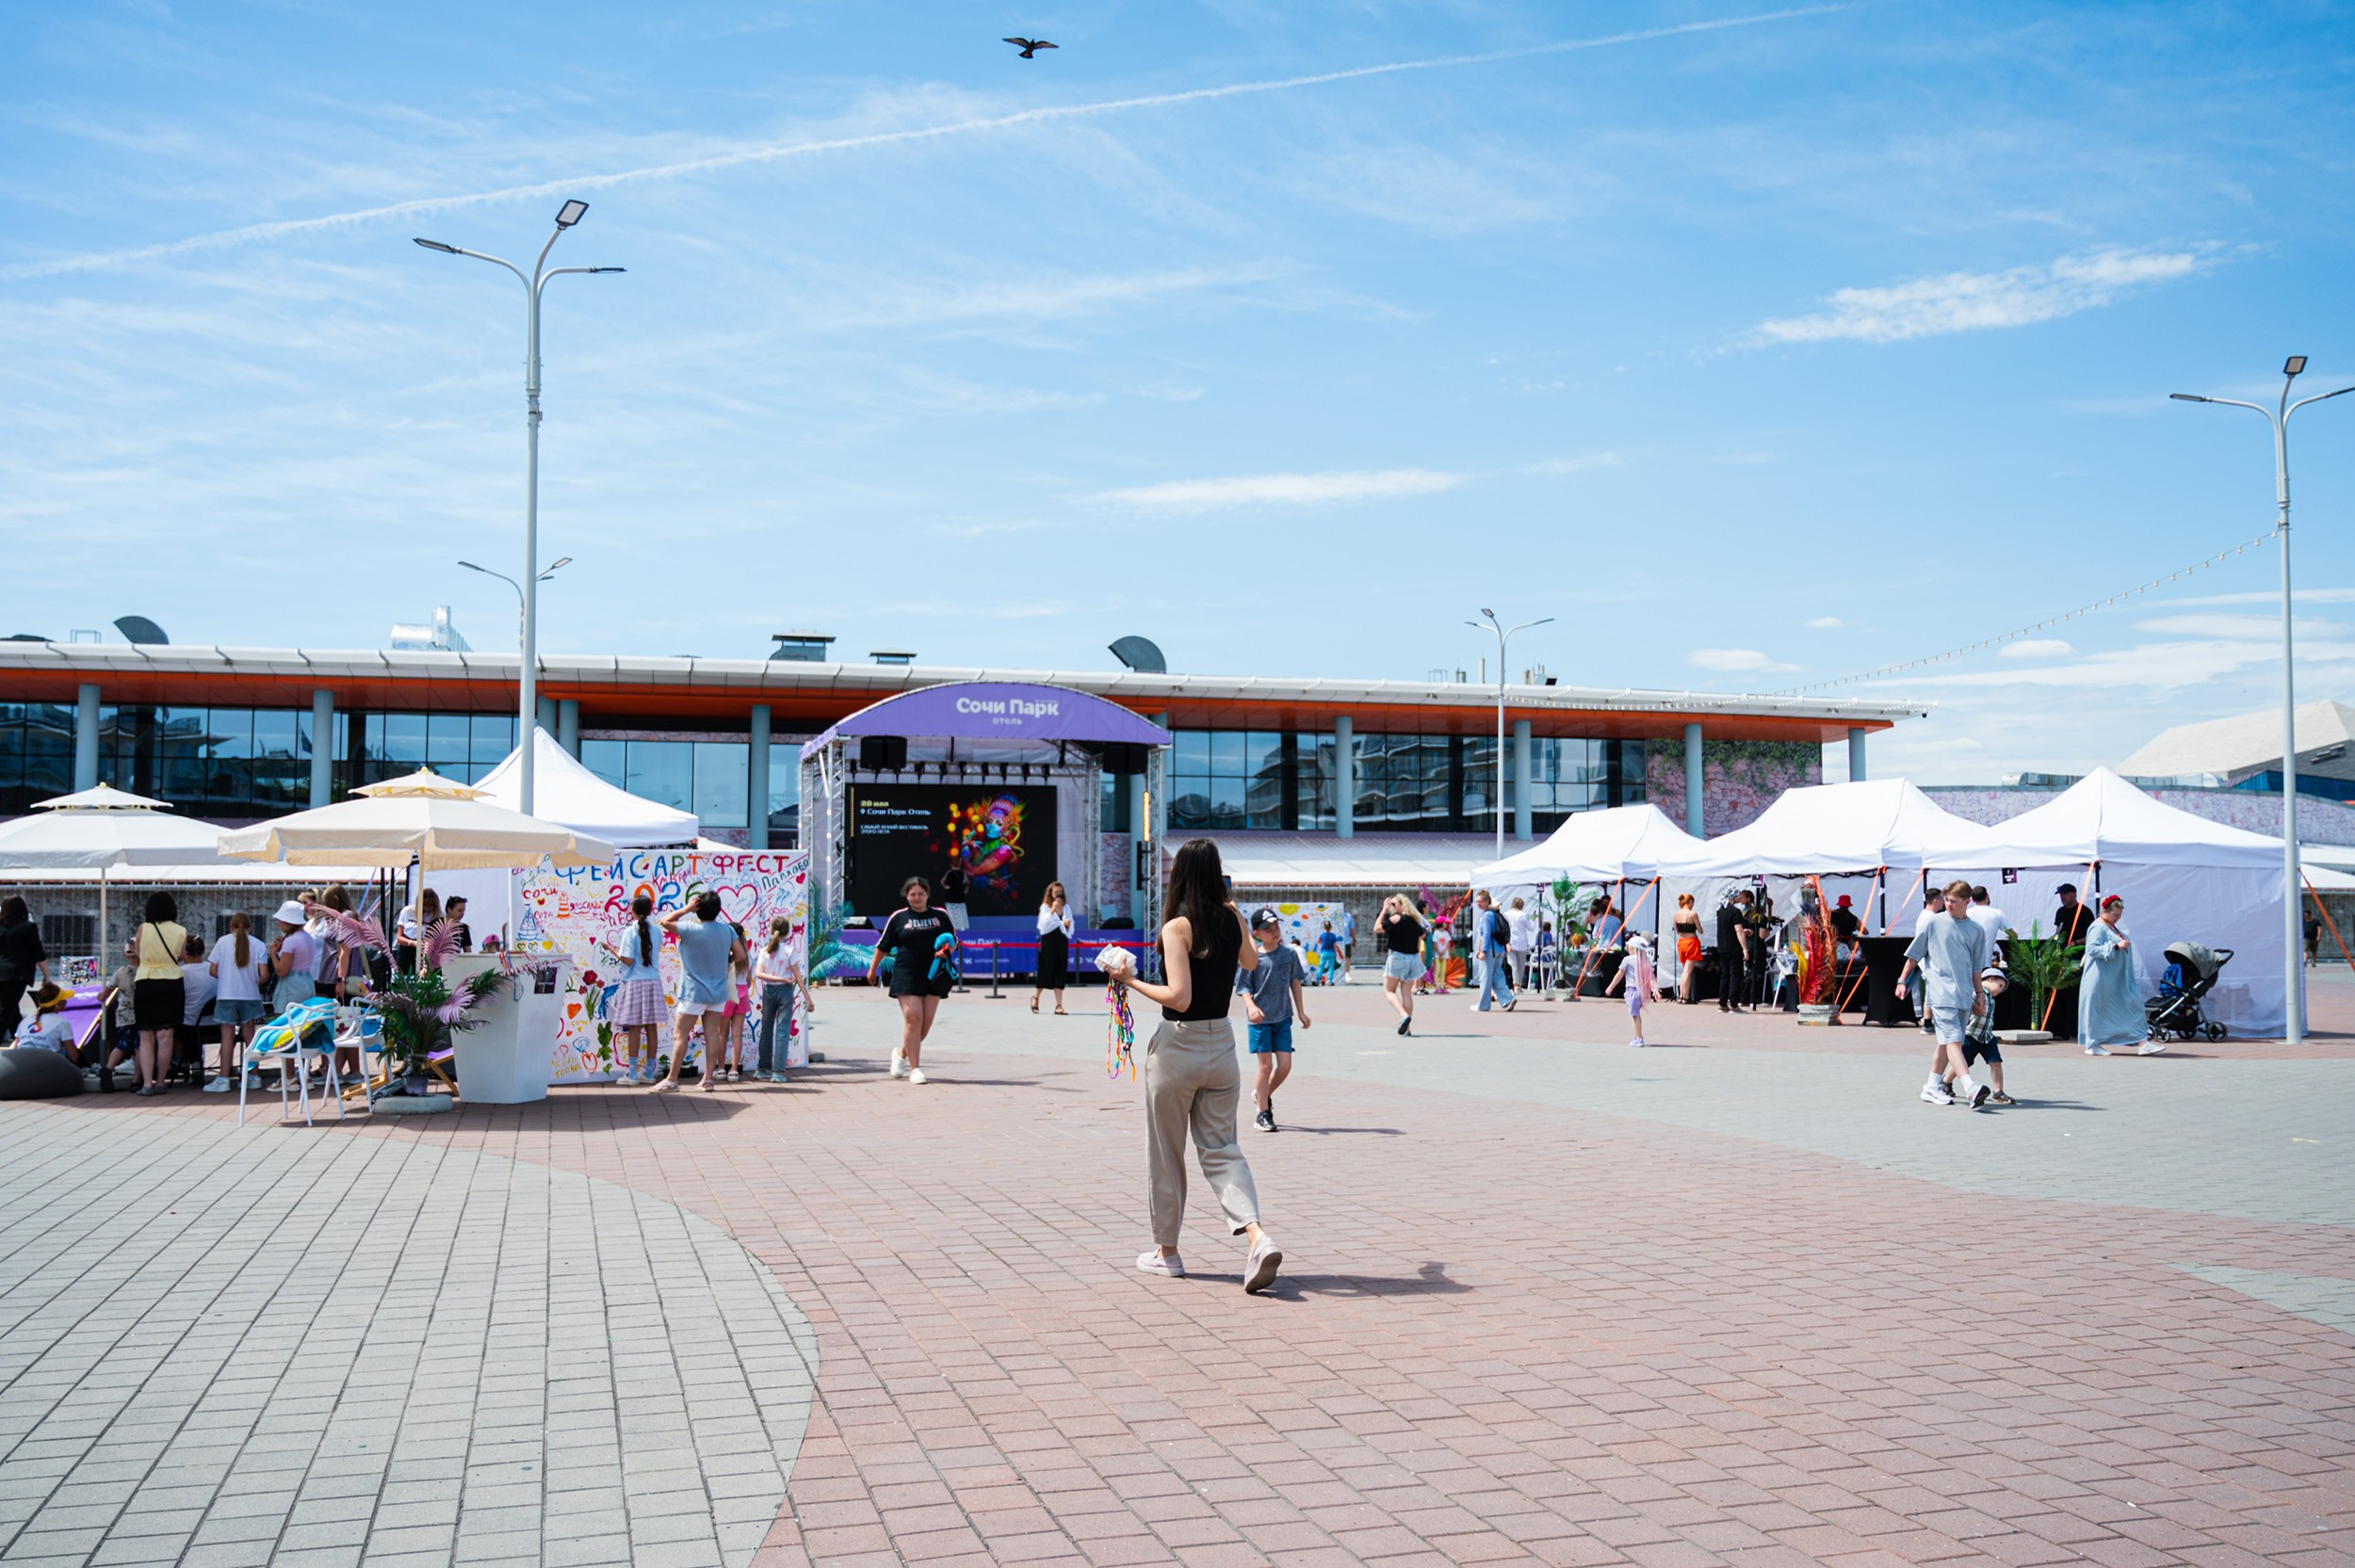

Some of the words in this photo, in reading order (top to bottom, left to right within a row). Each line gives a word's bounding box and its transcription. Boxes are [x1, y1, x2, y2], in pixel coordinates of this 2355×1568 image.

[956, 697, 1005, 714] Сочи
[1009, 699, 1060, 719] Парк
[992, 717, 1023, 725] отель
[654, 854, 703, 877] АРТ
[712, 854, 789, 875] ФЕСТ
